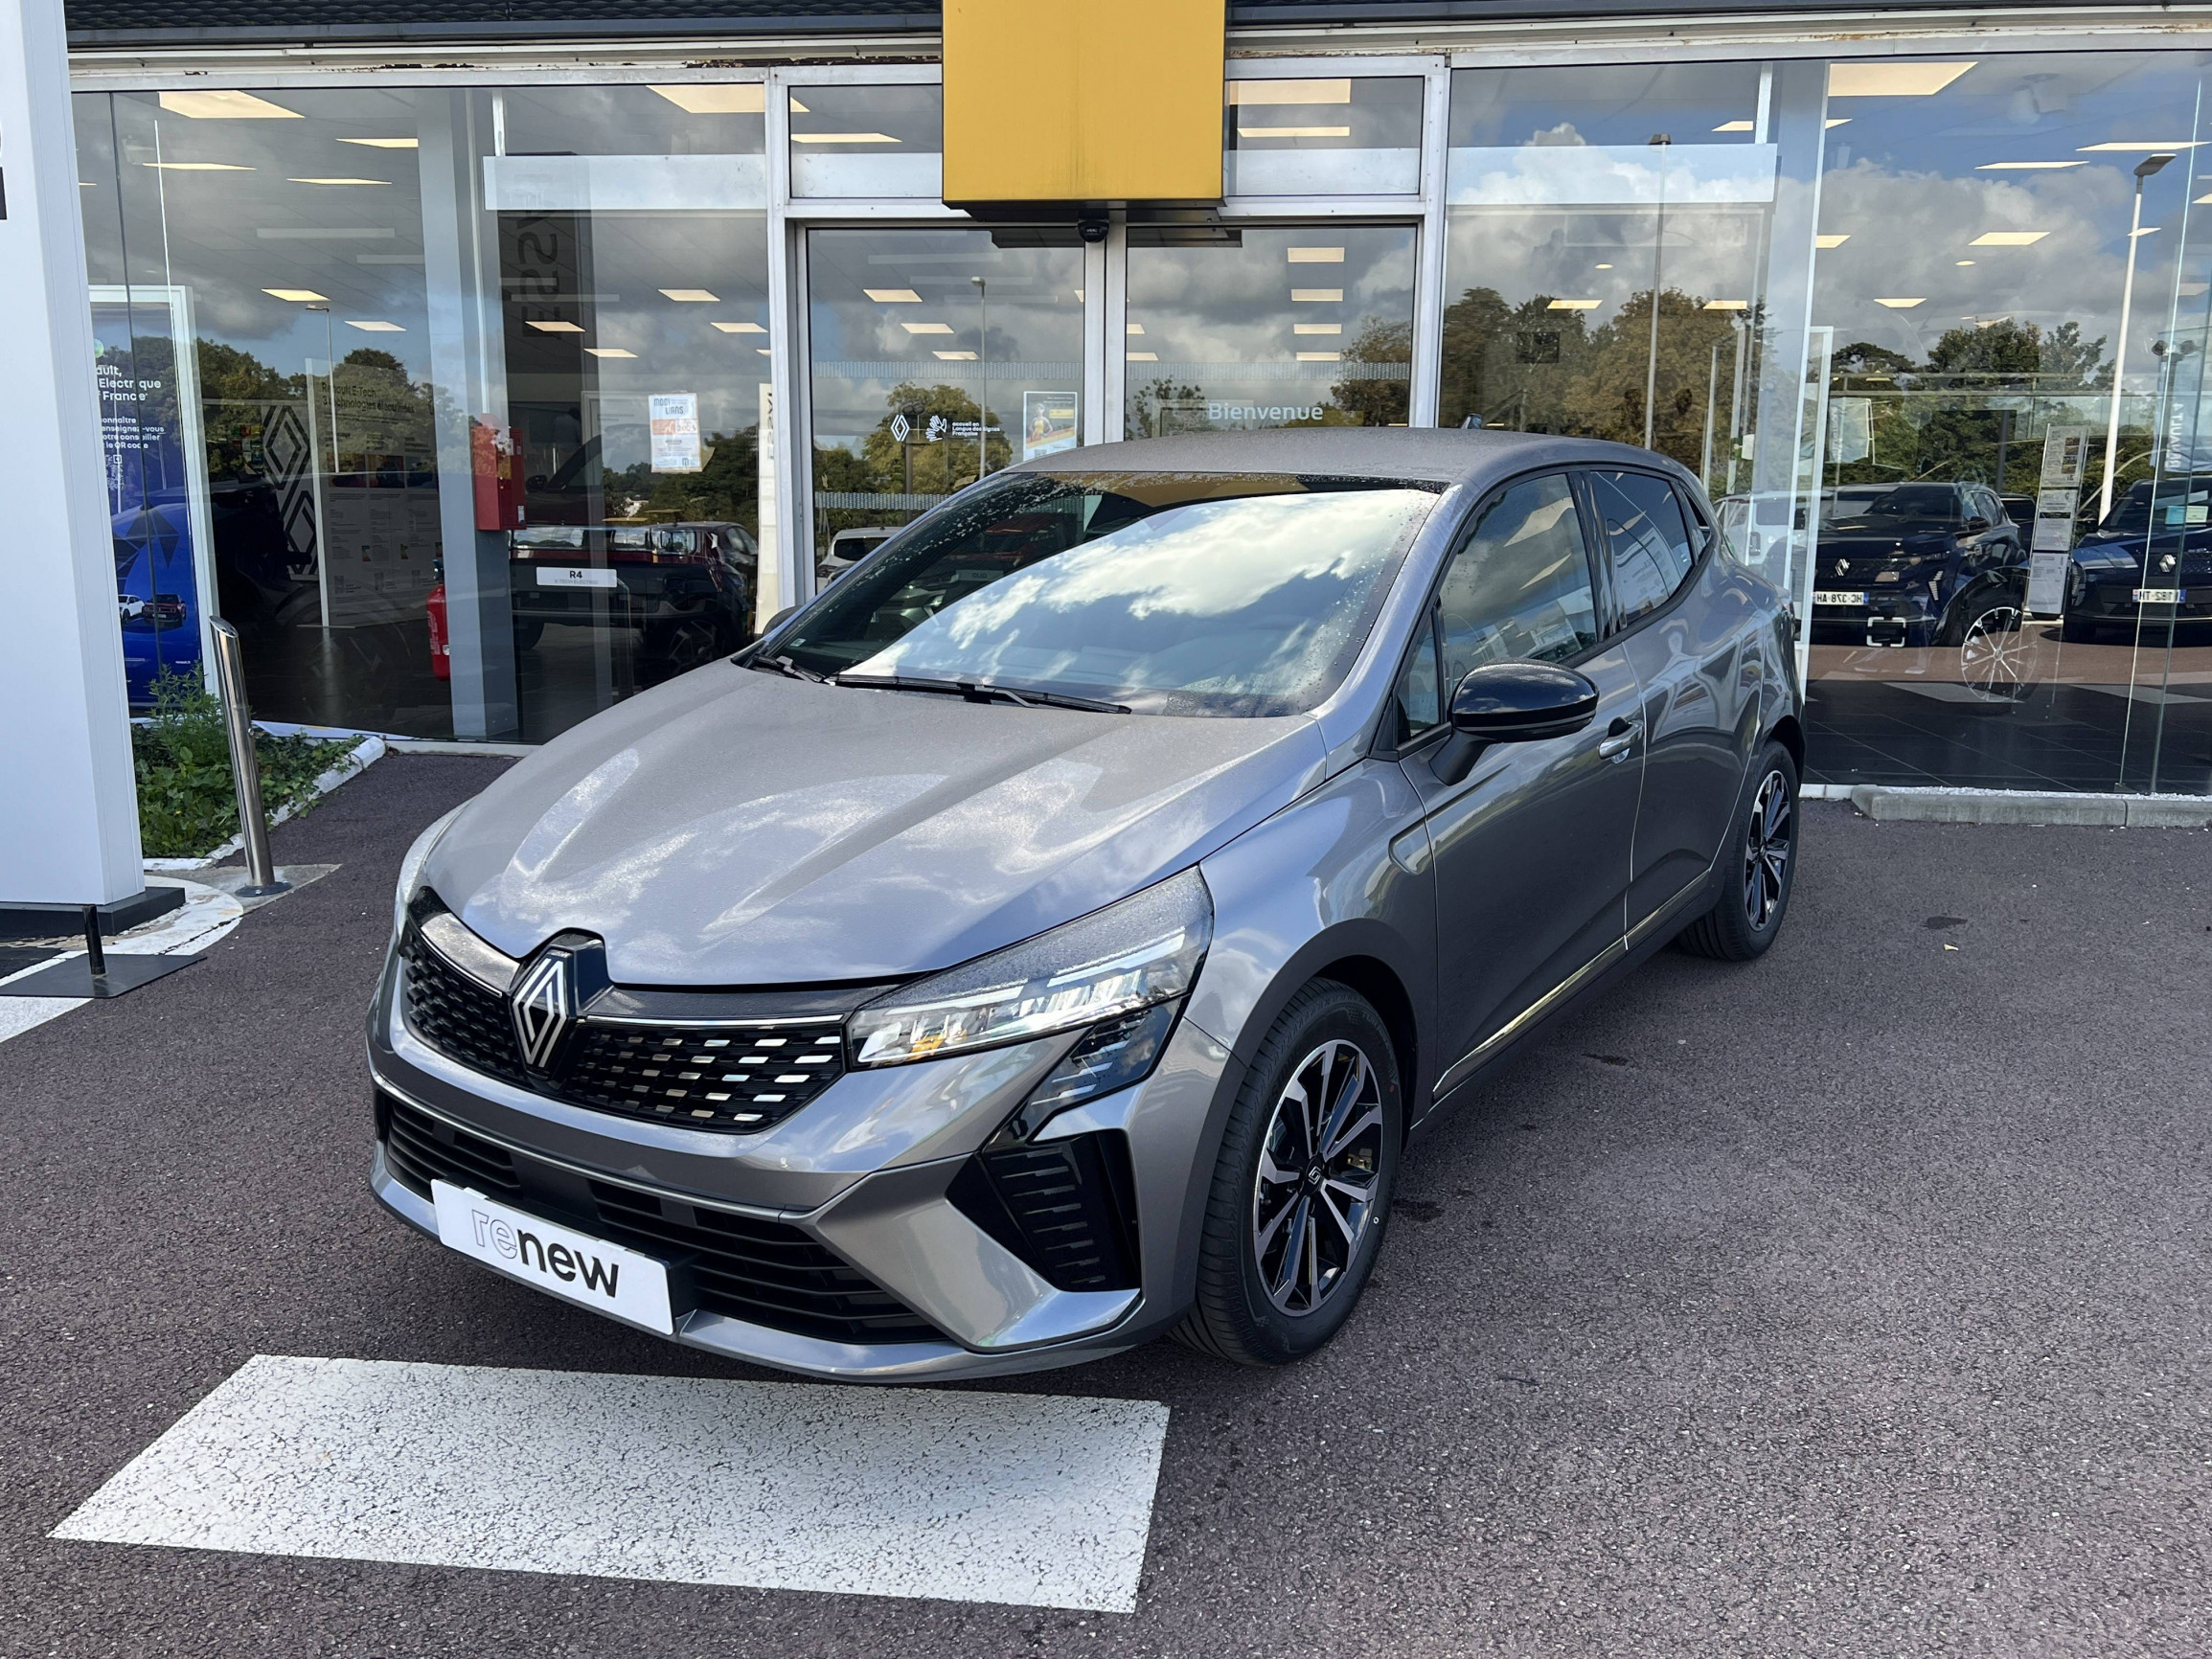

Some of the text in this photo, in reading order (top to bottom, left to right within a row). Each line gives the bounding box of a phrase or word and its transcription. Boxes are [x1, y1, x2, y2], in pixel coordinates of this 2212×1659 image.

[99, 377, 161, 391] Electrque
[1207, 401, 1324, 420] Bienvenue
[569, 570, 582, 580] R4
[471, 1209, 620, 1299] renew
